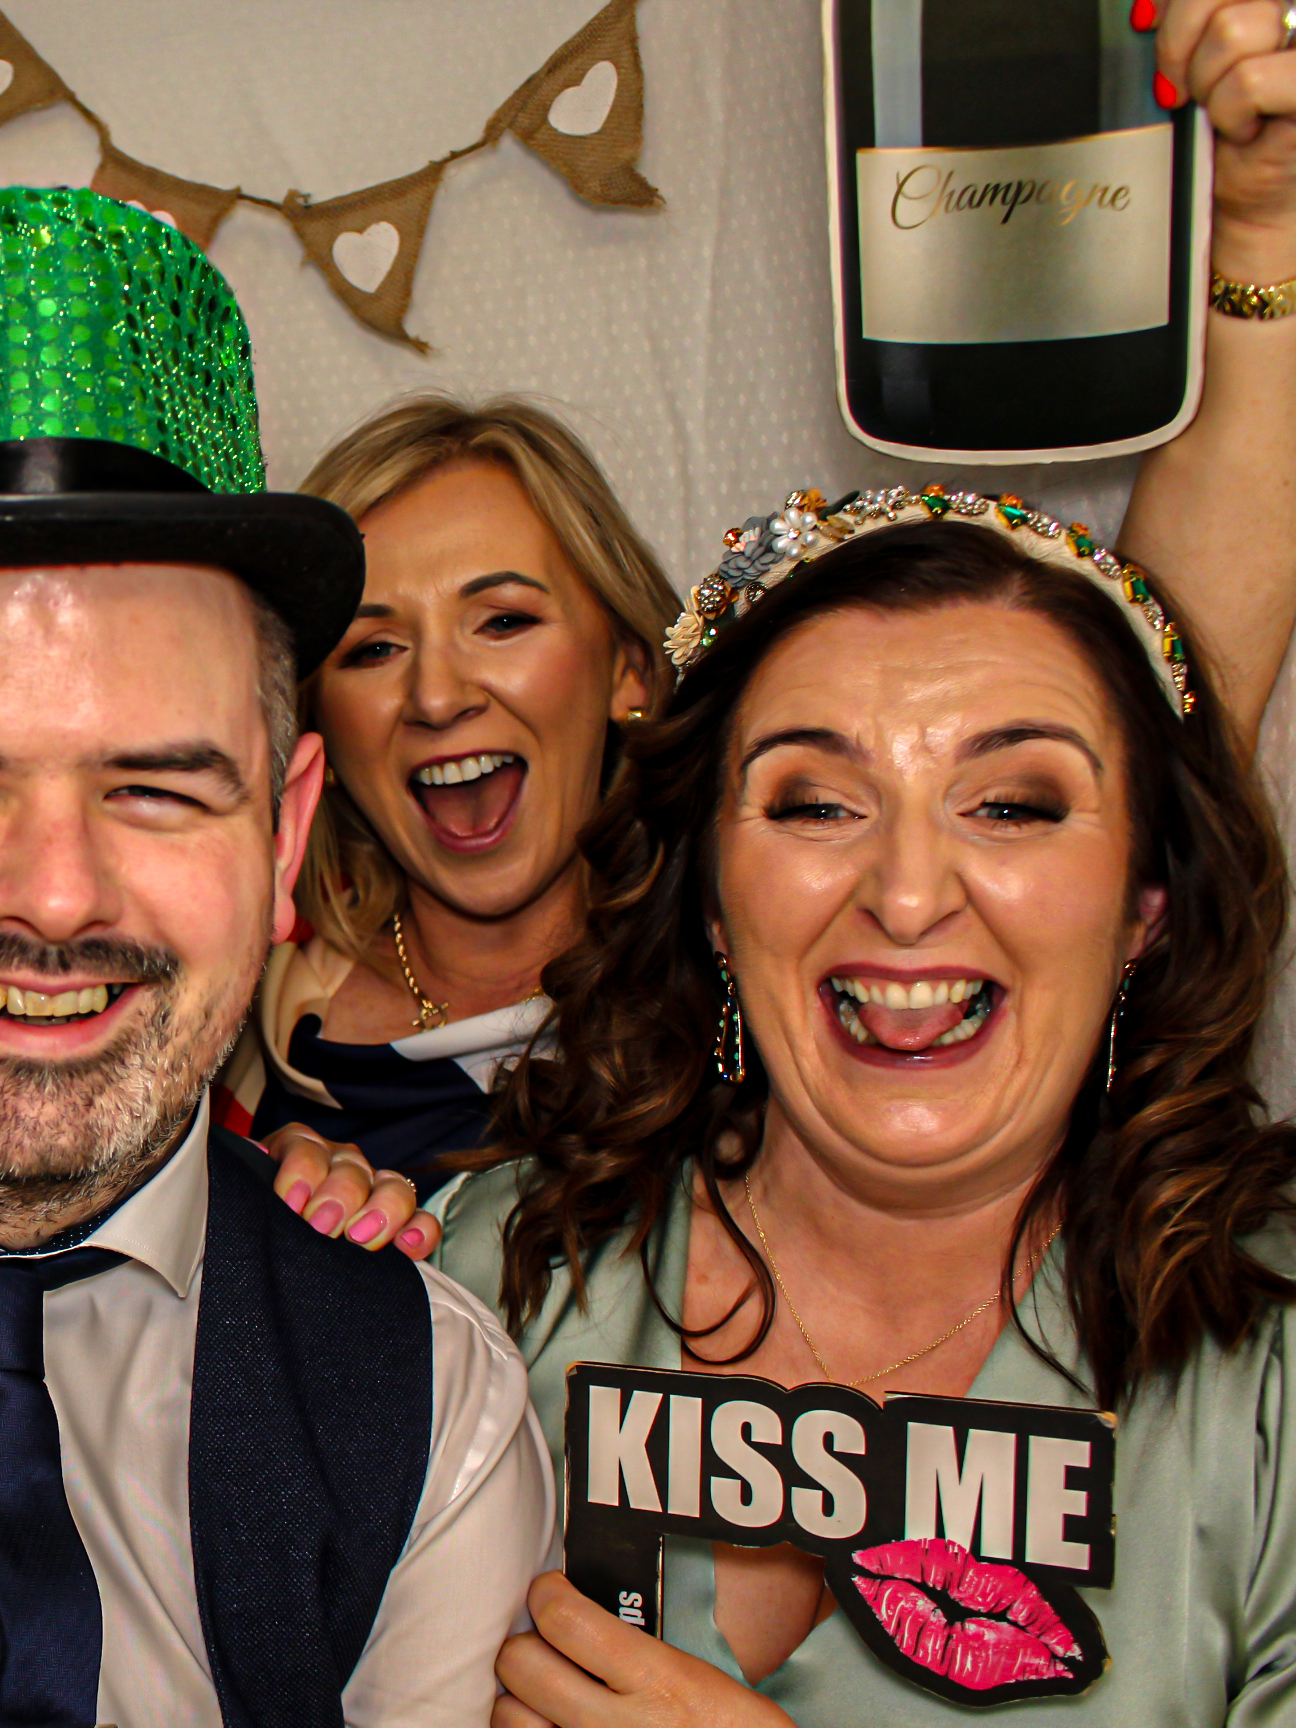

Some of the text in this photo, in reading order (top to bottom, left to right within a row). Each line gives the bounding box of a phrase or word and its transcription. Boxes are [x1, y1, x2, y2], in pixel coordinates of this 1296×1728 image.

[891, 164, 1131, 230] Champagne
[588, 1385, 1091, 1570] KISS ME
[618, 1591, 646, 1629] ps
